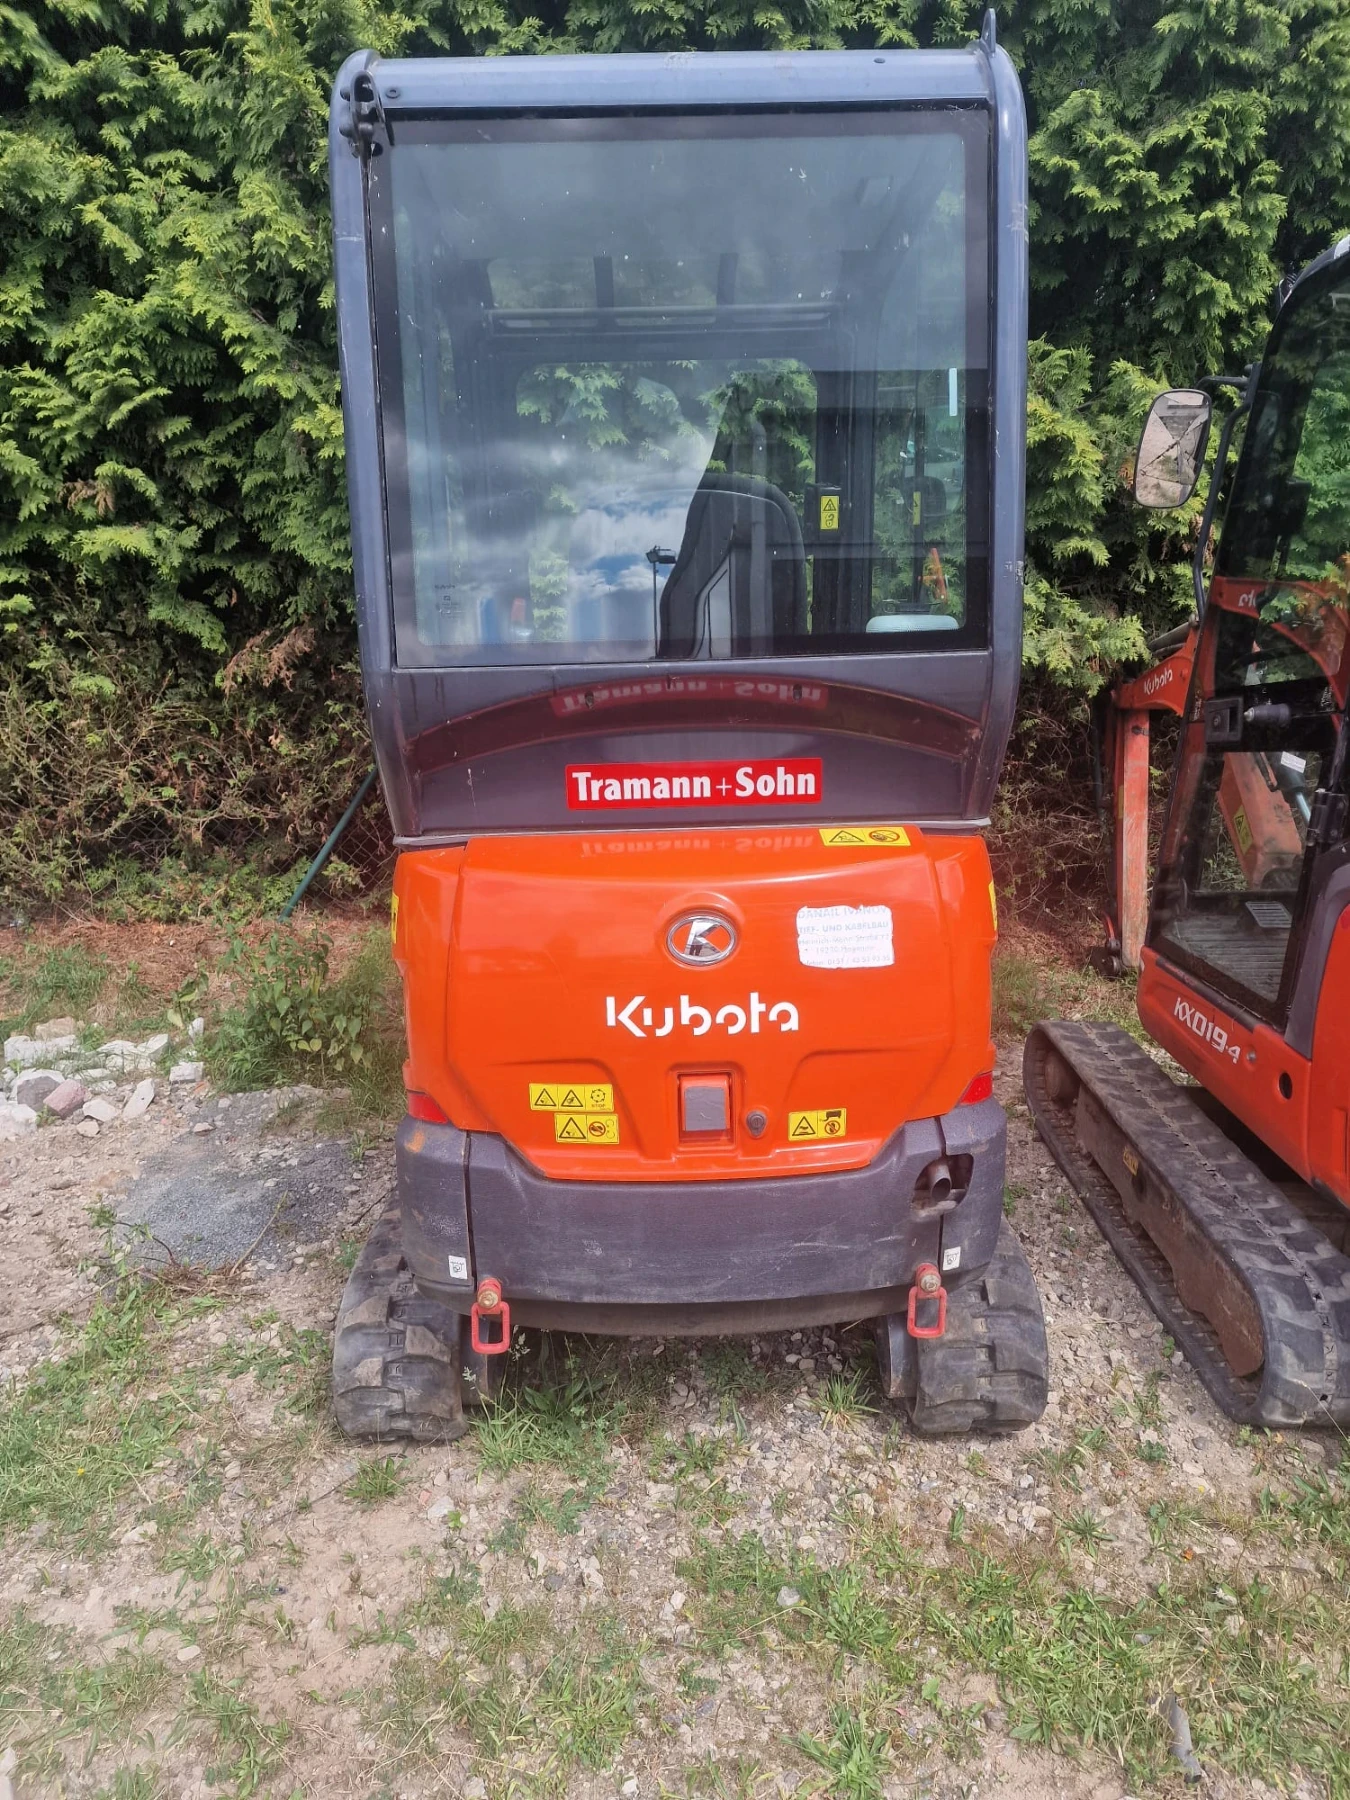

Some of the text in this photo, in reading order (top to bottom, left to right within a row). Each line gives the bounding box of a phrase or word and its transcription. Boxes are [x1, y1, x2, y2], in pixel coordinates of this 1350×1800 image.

[1143, 667, 1173, 695] Kubota
[822, 923, 842, 933] UND
[606, 992, 799, 1037] Kubota
